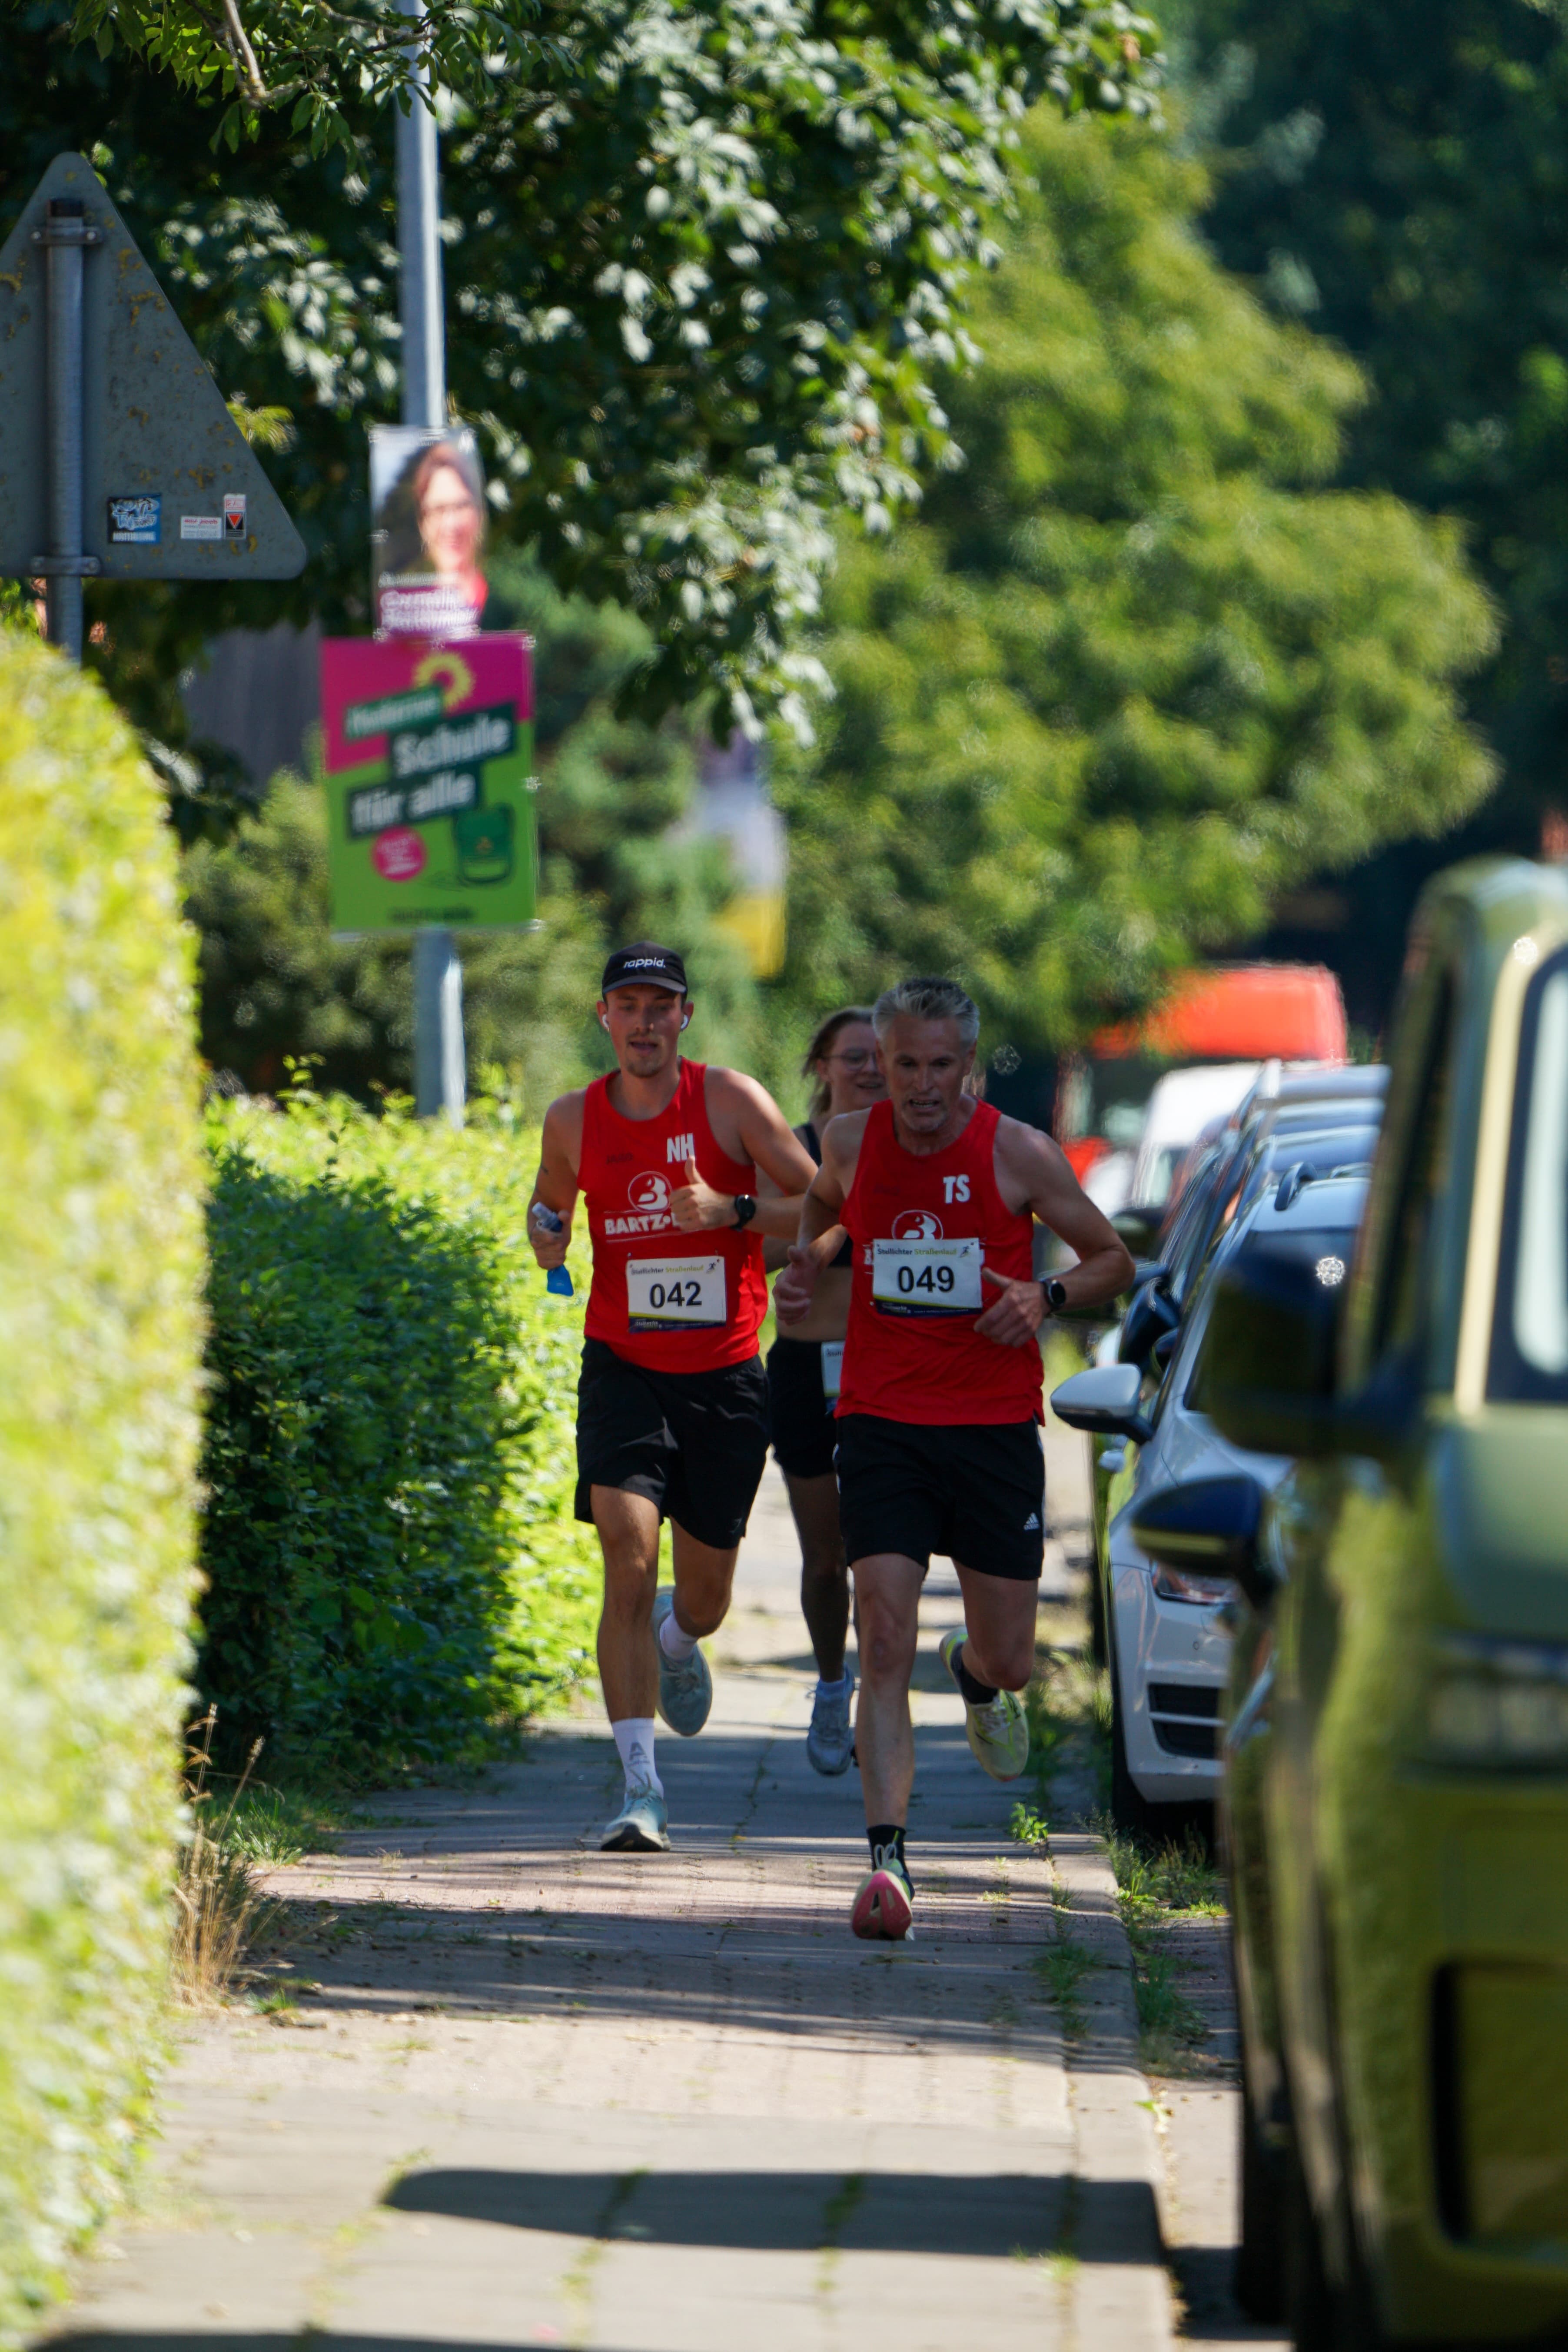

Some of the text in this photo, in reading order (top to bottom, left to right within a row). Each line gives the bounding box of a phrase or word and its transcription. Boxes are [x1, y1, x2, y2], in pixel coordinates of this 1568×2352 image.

[395, 715, 510, 778] Schule
[352, 771, 475, 832] für alle
[624, 957, 666, 968] rappid.
[667, 1133, 694, 1163] NH
[943, 1174, 970, 1204] TS
[898, 1266, 954, 1292] 049
[650, 1281, 702, 1309] 042
